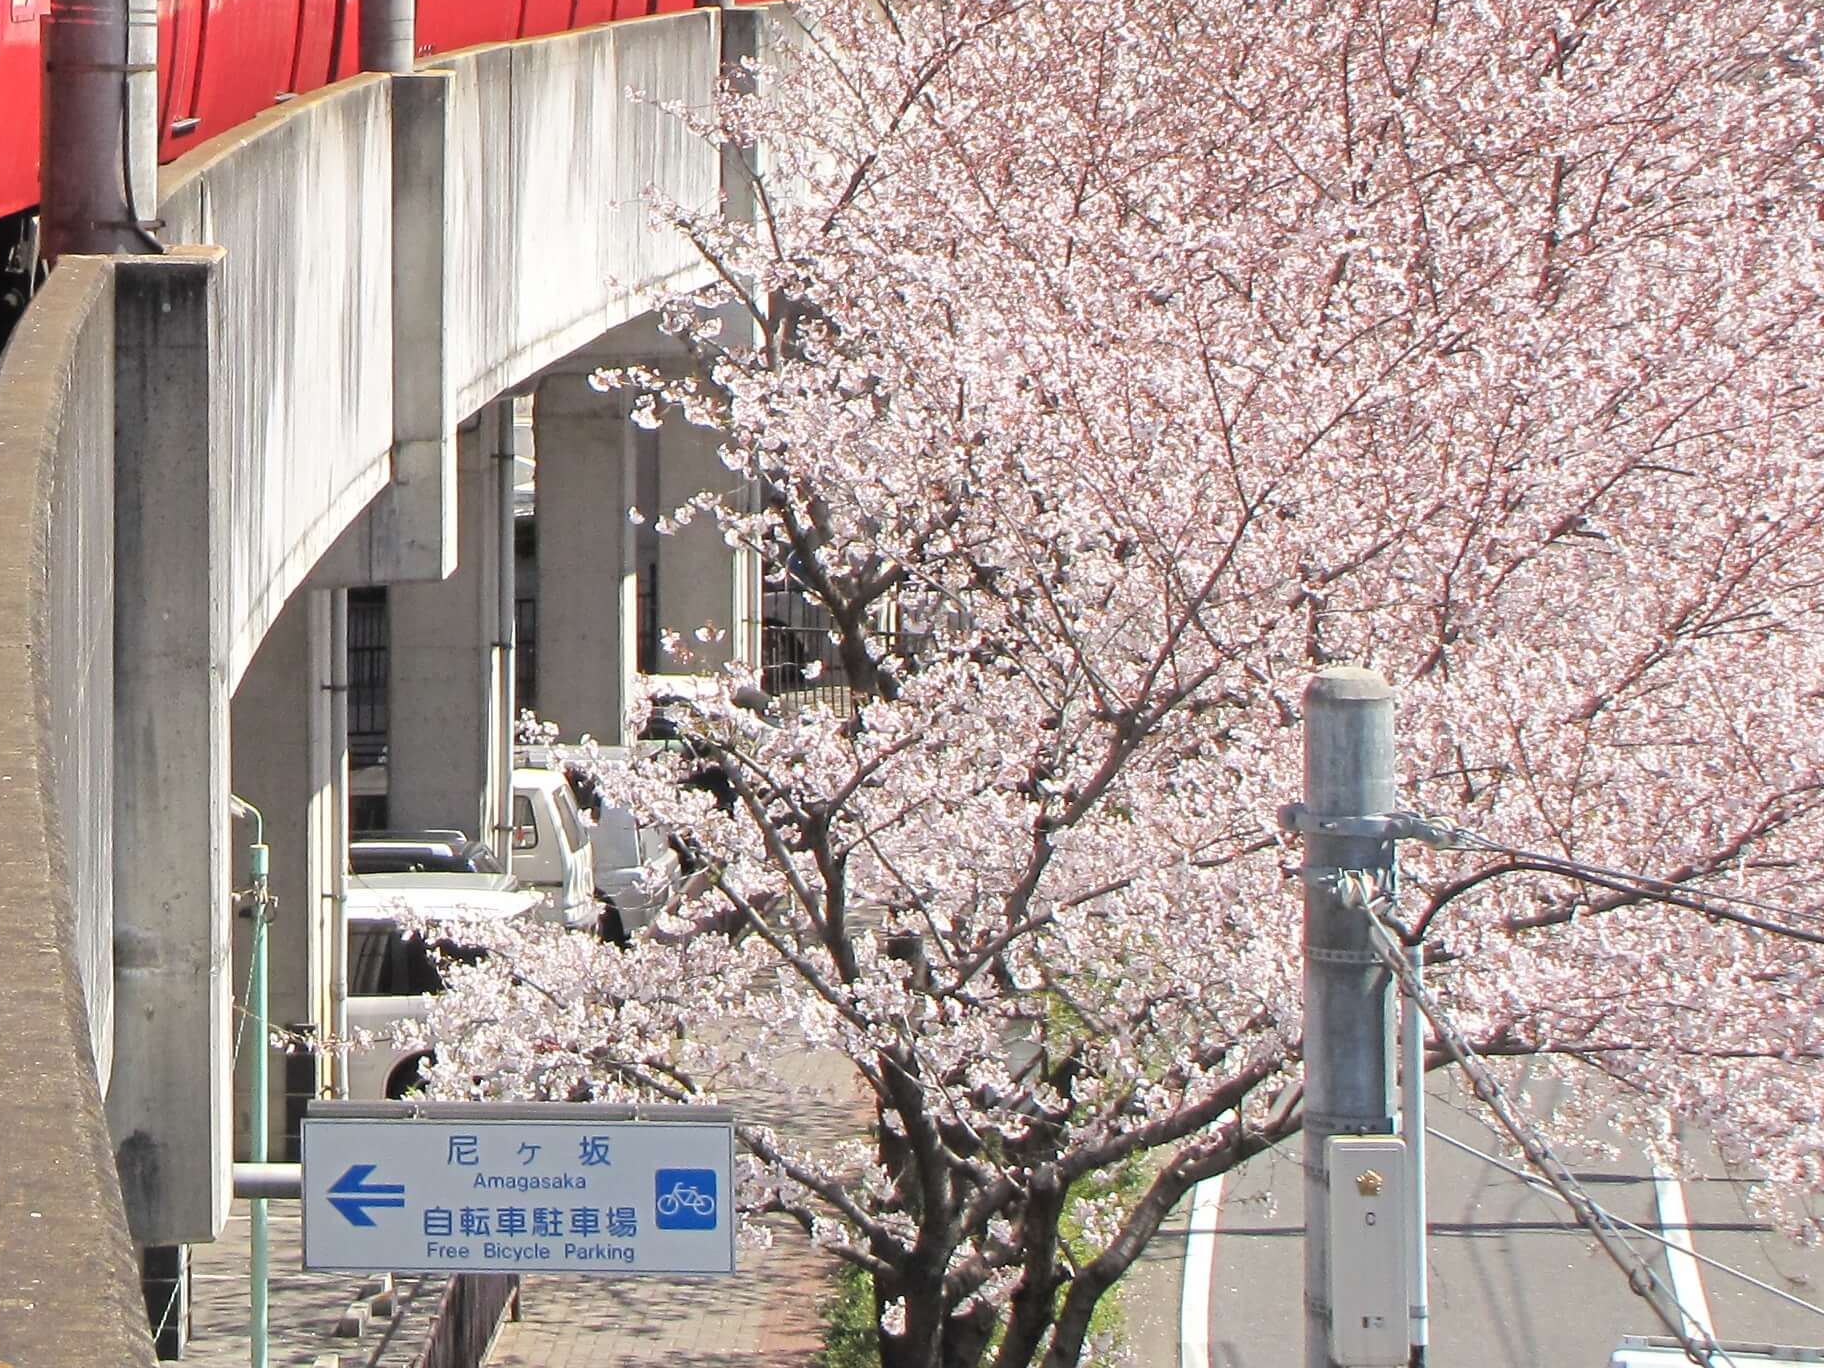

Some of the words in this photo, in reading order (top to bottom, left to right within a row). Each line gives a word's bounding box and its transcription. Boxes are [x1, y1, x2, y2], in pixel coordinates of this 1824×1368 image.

[473, 1172, 587, 1193] Amagasaka
[423, 1206, 639, 1238] 自転車駐車場
[426, 1242, 470, 1259] Free
[483, 1242, 550, 1263] Bicycle
[564, 1242, 635, 1264] Parking
